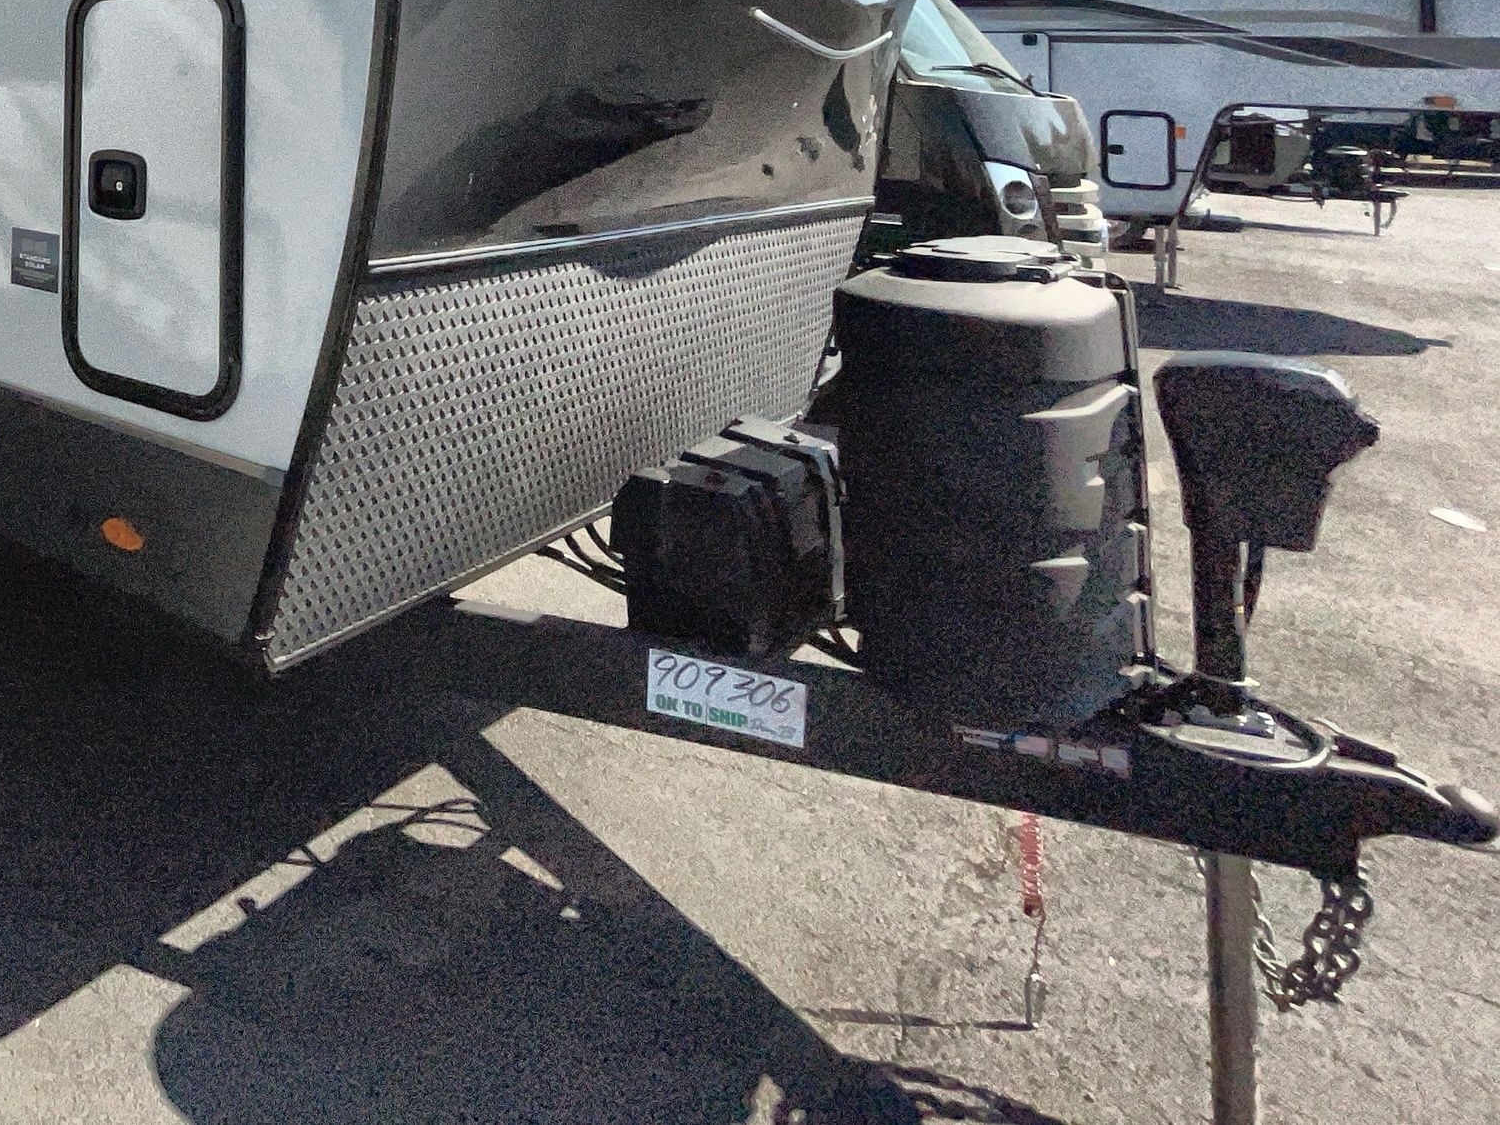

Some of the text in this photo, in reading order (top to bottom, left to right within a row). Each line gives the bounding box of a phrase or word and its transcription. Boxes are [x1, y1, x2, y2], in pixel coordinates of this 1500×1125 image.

[655, 693, 680, 713] OK
[682, 699, 703, 719] TO
[707, 706, 748, 729] SHIP
